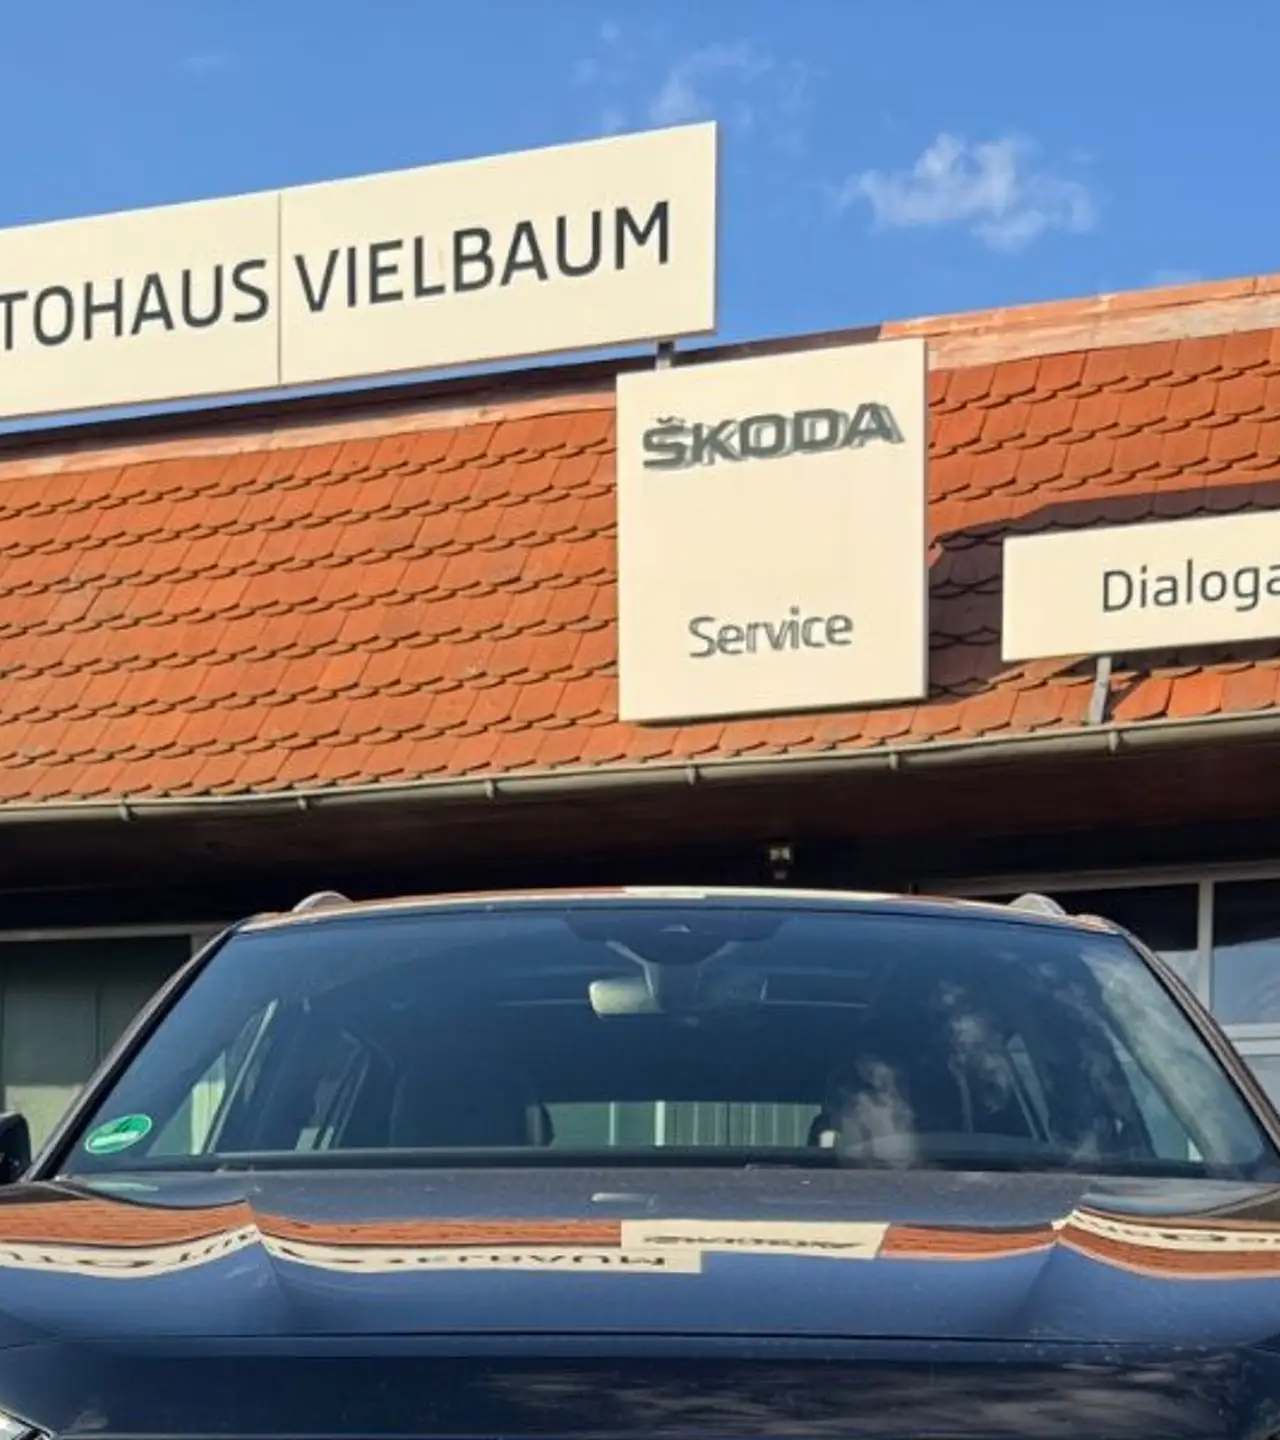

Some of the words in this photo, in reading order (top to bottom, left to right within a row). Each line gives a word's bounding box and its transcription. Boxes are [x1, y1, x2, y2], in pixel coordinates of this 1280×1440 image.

[295, 200, 671, 314] VIELBAUM
[642, 402, 905, 469] ŠKODA
[688, 605, 854, 658] Service
